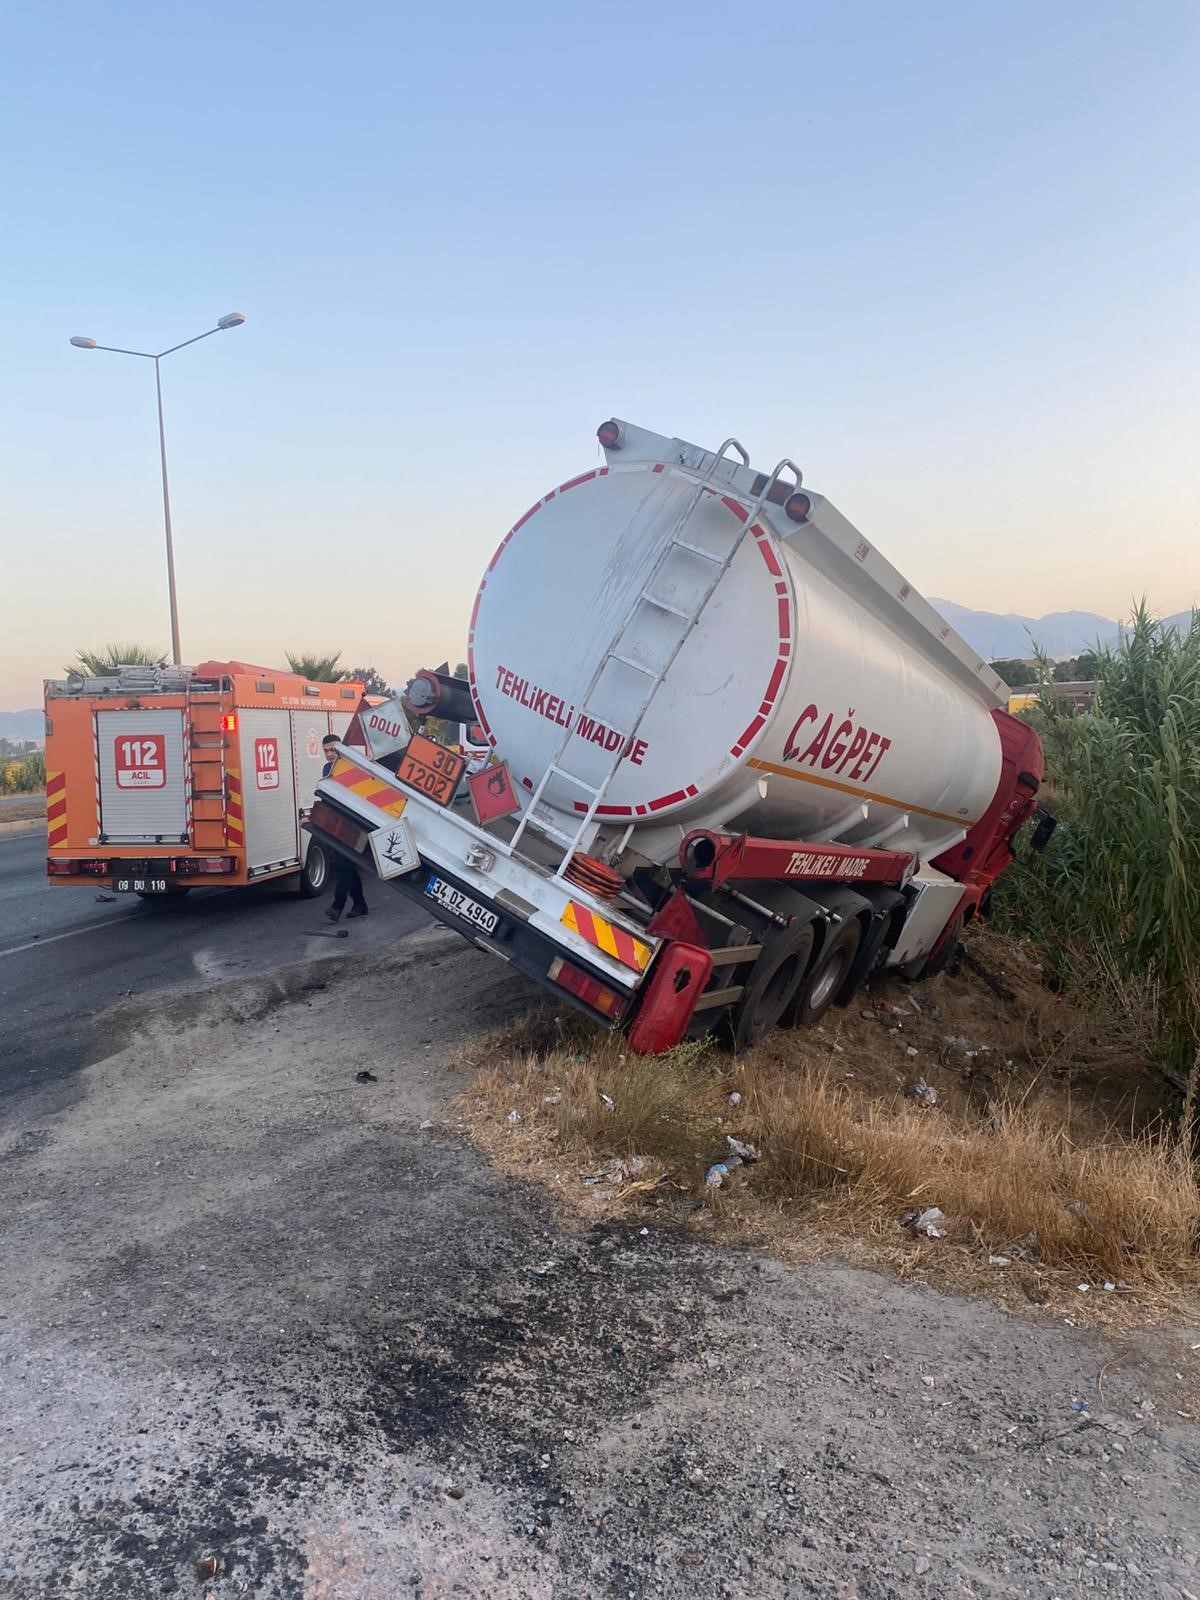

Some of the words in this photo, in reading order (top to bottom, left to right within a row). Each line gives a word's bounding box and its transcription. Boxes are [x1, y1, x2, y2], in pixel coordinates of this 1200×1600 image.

[369, 714, 401, 738] DOLU
[576, 713, 649, 766] MADDE
[122, 741, 158, 766] 112
[258, 743, 276, 768] 112
[433, 751, 456, 776] 30
[406, 763, 447, 799] 1202
[835, 857, 871, 877] MADDE
[118, 880, 129, 890] 09
[134, 880, 145, 890] DU
[151, 880, 166, 890] 110
[433, 880, 447, 898] 34
[449, 891, 466, 909] DZ
[466, 902, 495, 929] 4940
